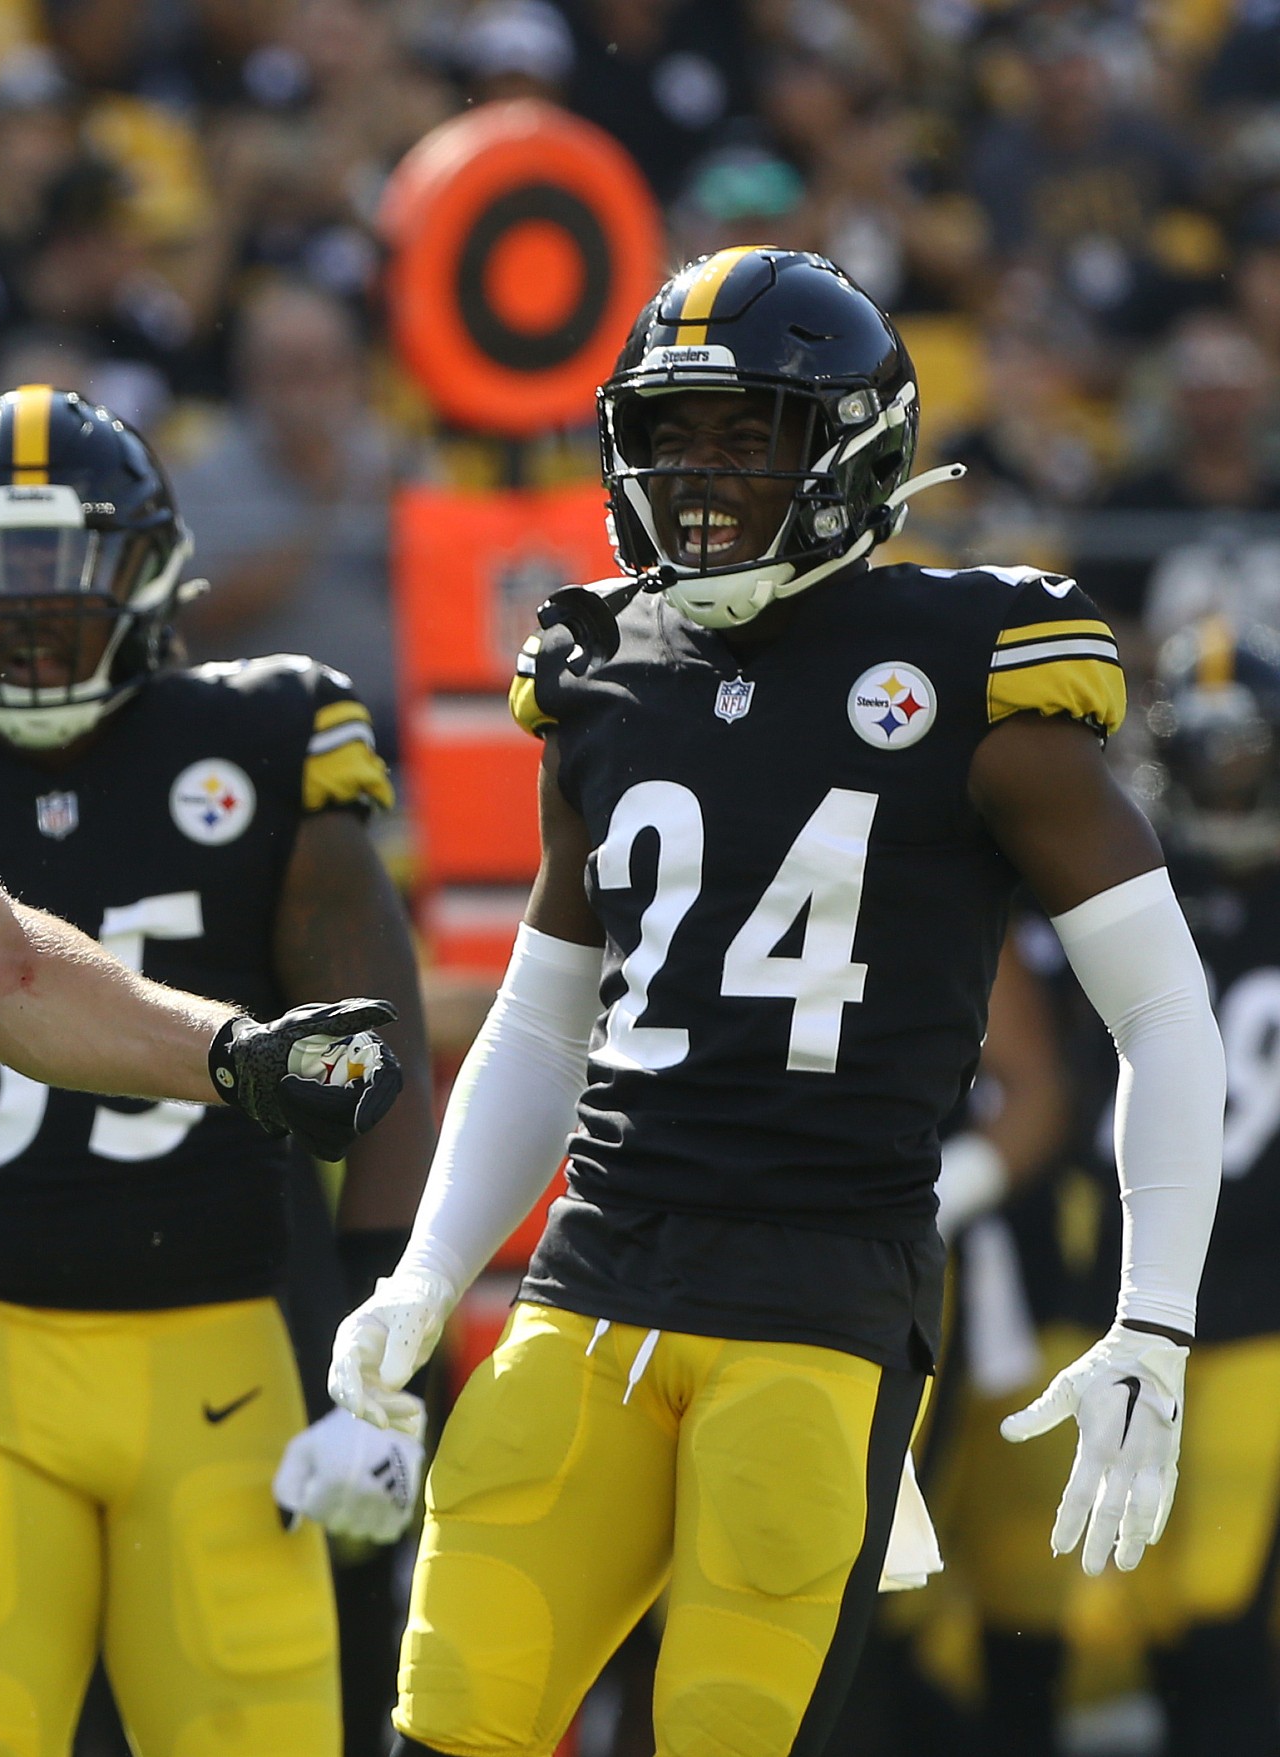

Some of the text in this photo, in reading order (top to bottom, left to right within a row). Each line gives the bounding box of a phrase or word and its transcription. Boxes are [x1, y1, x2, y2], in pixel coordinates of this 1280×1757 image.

[662, 347, 710, 364] Steelers
[721, 696, 746, 713] NFL
[857, 696, 889, 708] Steelers
[587, 780, 879, 1074] 24
